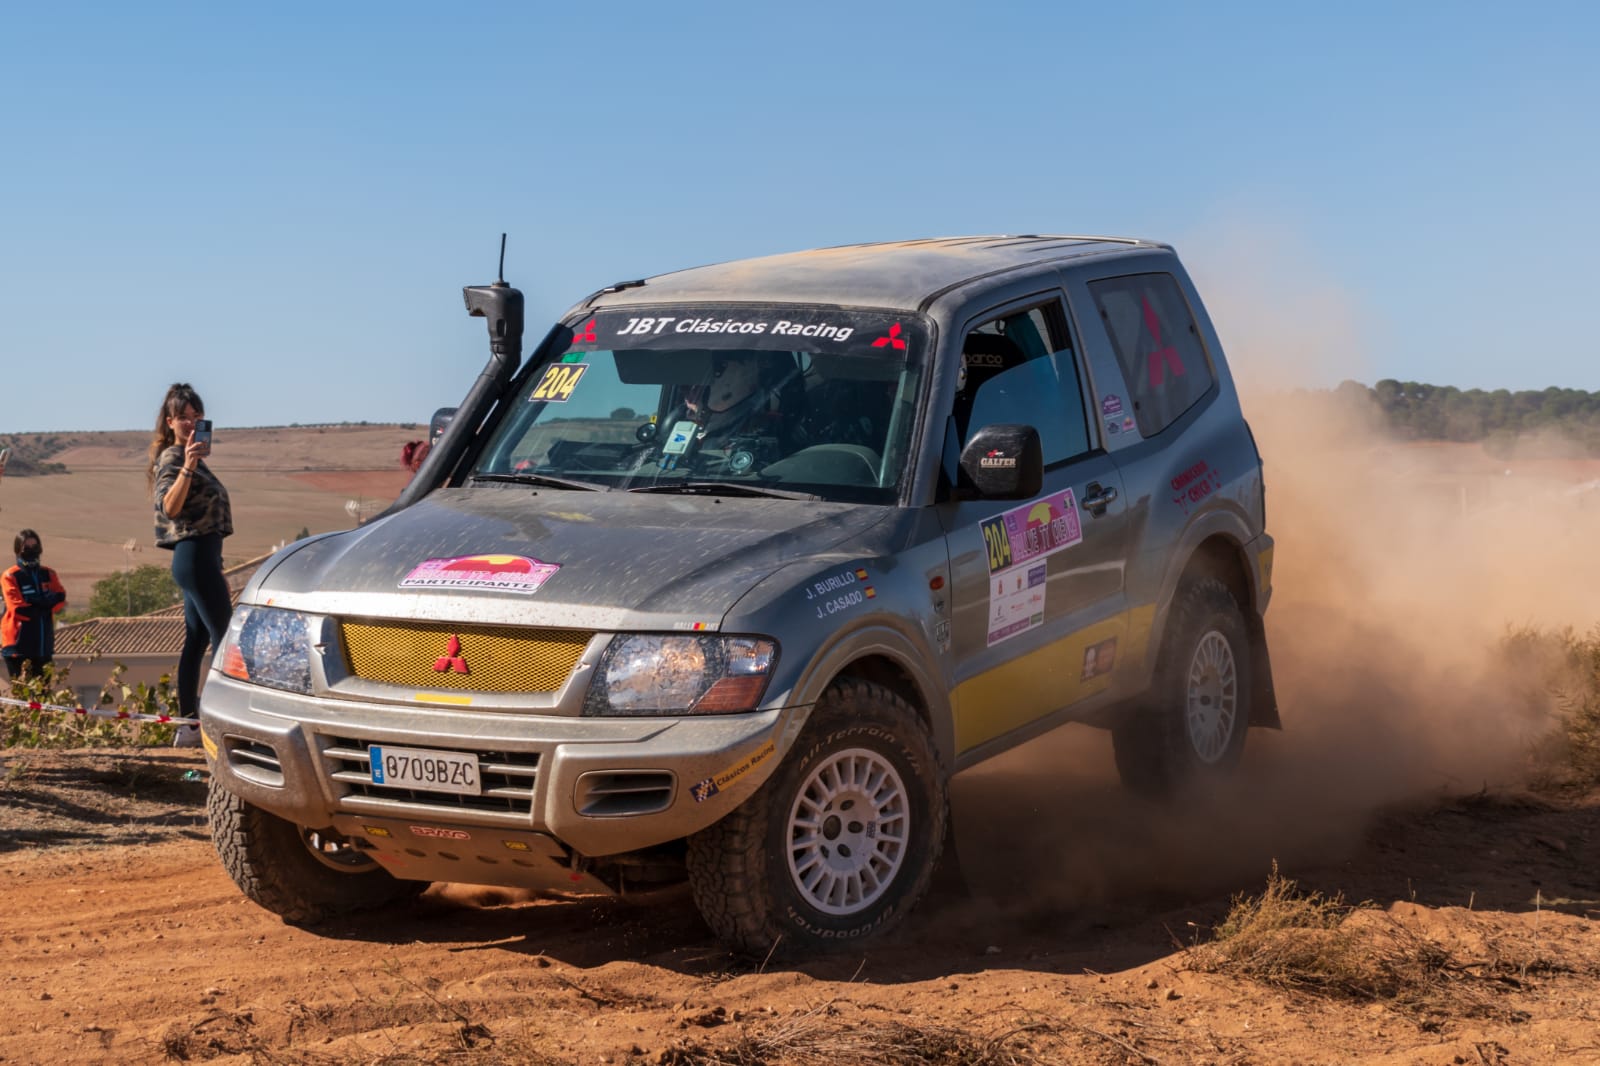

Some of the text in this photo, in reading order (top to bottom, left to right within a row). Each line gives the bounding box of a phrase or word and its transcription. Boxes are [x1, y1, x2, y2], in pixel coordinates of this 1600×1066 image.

[617, 317, 854, 342] JBT Clásicos Racing
[532, 366, 583, 400] 204
[980, 457, 1017, 466] GALFER
[984, 520, 1012, 569] 204
[403, 579, 535, 590] PARTICIPANTE
[805, 571, 856, 600] J. BURILLO
[816, 591, 863, 619] J. CASADO
